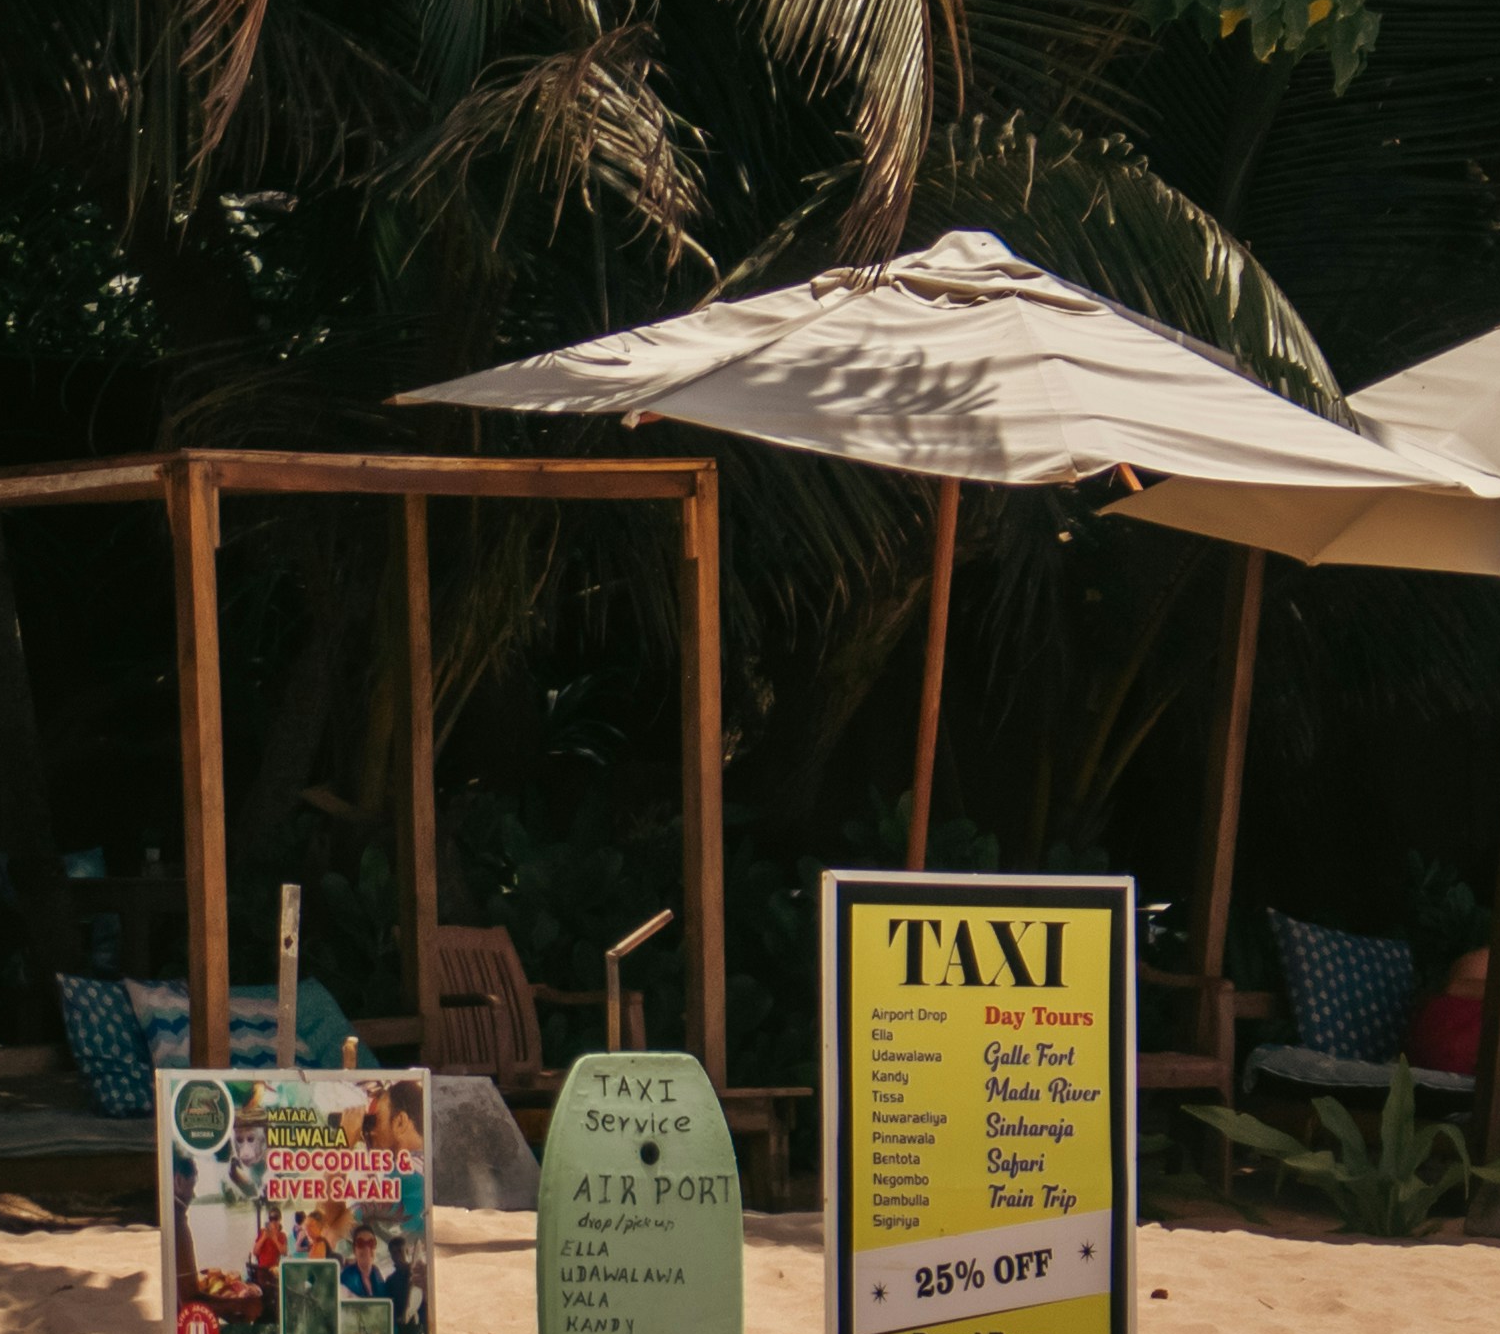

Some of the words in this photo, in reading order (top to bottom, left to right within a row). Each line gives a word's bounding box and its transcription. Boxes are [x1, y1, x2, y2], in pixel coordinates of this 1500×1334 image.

[888, 918, 1071, 989] TAXI
[872, 1008, 914, 1022] Airport
[919, 1009, 947, 1023] Drop
[985, 1006, 1025, 1030] Day
[1032, 1007, 1094, 1026] Tours
[872, 1029, 893, 1041] Ella
[872, 1050, 942, 1062] Udawalawa
[984, 1041, 1031, 1072] Galle
[1036, 1043, 1075, 1066] Fort
[872, 1071, 909, 1085] Kandy
[594, 1075, 676, 1102] TAXI
[872, 1091, 904, 1103] Tissa
[985, 1077, 1040, 1102] Madu
[1048, 1077, 1100, 1103] River
[267, 1108, 317, 1123] MATARA
[585, 1109, 691, 1134] Service
[872, 1111, 947, 1126] Nuwaraeliya
[267, 1127, 348, 1147] NILWALA
[986, 1112, 1074, 1143] Sinharaja
[872, 1132, 935, 1144] Pinnawala
[268, 1149, 394, 1172] CROCODILES
[398, 1150, 413, 1173] &
[873, 1153, 920, 1165] Bentota
[987, 1148, 1045, 1178] Safari
[268, 1179, 327, 1201] RIVER
[332, 1178, 401, 1201] SAFARI
[573, 1174, 636, 1205] AIR
[654, 1174, 735, 1205] PORT
[873, 1173, 929, 1188] Negombo
[873, 1194, 929, 1206] Dambulla
[989, 1185, 1034, 1208] Train
[1042, 1185, 1077, 1214] Trip
[873, 1215, 920, 1230] Sigiriya
[561, 1240, 609, 1257] ELLA
[561, 1265, 685, 1284] UDAWALAWA
[915, 1258, 985, 1298] 25%
[994, 1248, 1053, 1284] OFF
[562, 1290, 609, 1308] YALA
